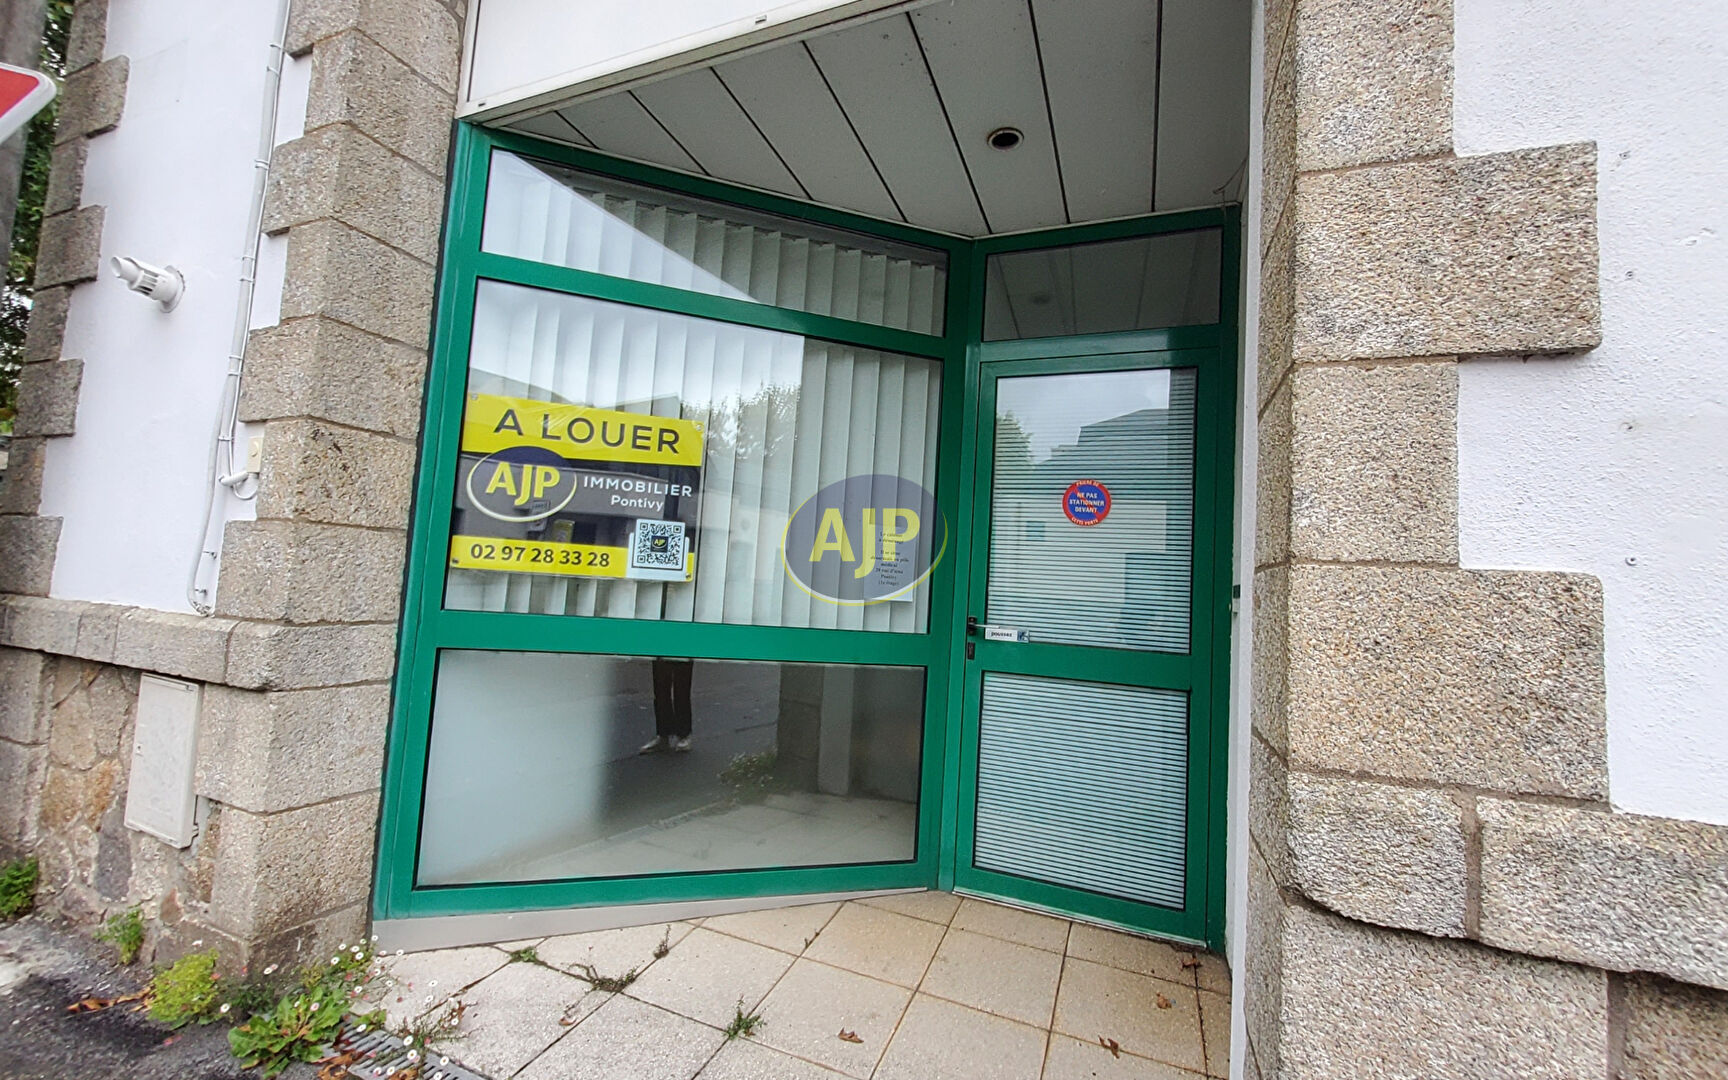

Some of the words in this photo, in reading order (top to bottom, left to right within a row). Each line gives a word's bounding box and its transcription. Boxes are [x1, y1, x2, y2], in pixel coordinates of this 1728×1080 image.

[494, 409, 523, 436] A
[541, 413, 680, 454] LOUER
[485, 462, 560, 506] AJP
[583, 476, 692, 498] IMMOBILIER
[611, 495, 664, 512] Pontivy
[471, 544, 495, 560] 02
[501, 546, 525, 562] 97
[531, 548, 554, 564] 28
[559, 550, 582, 566] 33
[587, 552, 610, 567] 28
